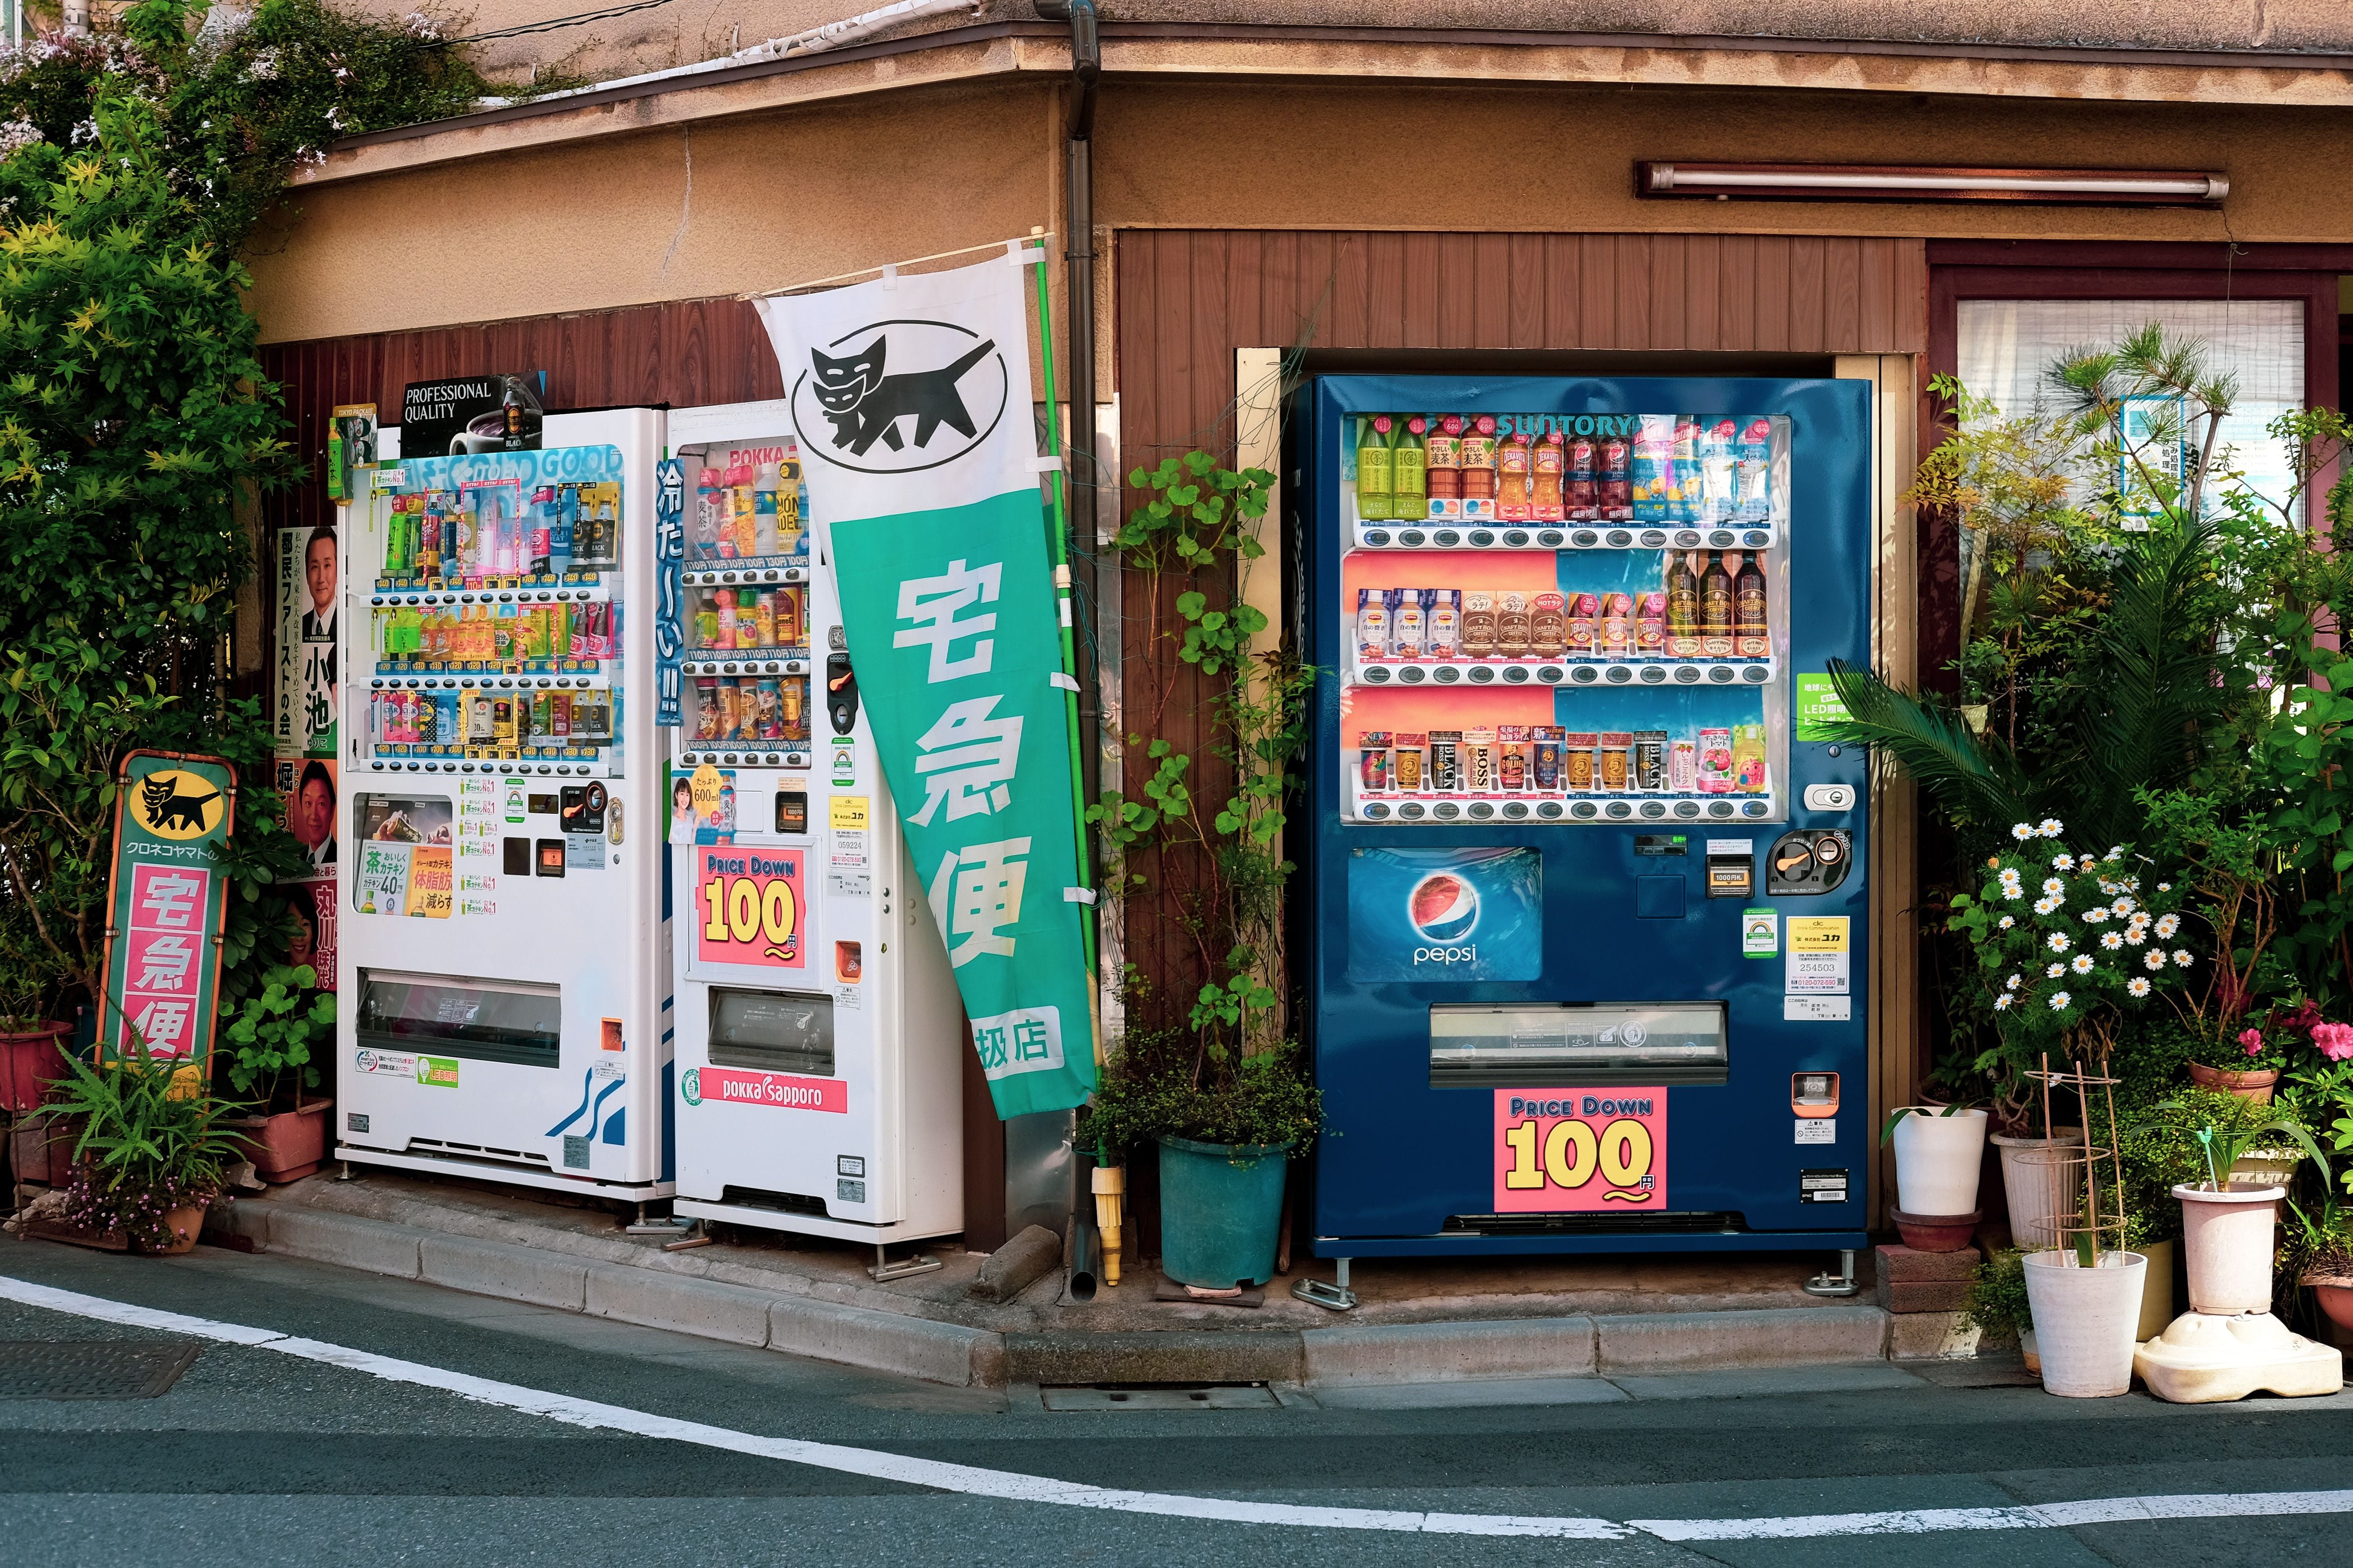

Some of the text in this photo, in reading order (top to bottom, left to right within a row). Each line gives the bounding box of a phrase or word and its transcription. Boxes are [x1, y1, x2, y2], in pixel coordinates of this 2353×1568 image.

[406, 382, 491, 404] PROFESSIONAL
[405, 403, 455, 423] QUALITY
[730, 446, 783, 468] POKKA
[1430, 453, 1450, 464] 麦茶
[1463, 453, 1483, 465] 麦茶
[698, 501, 707, 528] 麦茶
[279, 532, 292, 735] 都民ファーストの会
[305, 647, 330, 735] 小池
[307, 739, 327, 749] ゆりこ
[1533, 728, 1545, 740] 新
[892, 558, 1033, 970] 宅急便
[1444, 746, 1454, 787] BLACK
[1477, 748, 1488, 786] BOSS
[1650, 746, 1660, 786] BLACK
[695, 789, 718, 801] 600ml
[724, 800, 730, 820] 麦茶
[127, 842, 217, 861] クロネコヤマトの
[706, 854, 795, 876] PRICE DOWN
[316, 886, 336, 989] 丸川珠代
[132, 874, 200, 1054] 宅急便
[1413, 943, 1476, 966] pepsi
[431, 1069, 457, 1082] LED照明
[1509, 1095, 1652, 1117] PRICE DOWN
